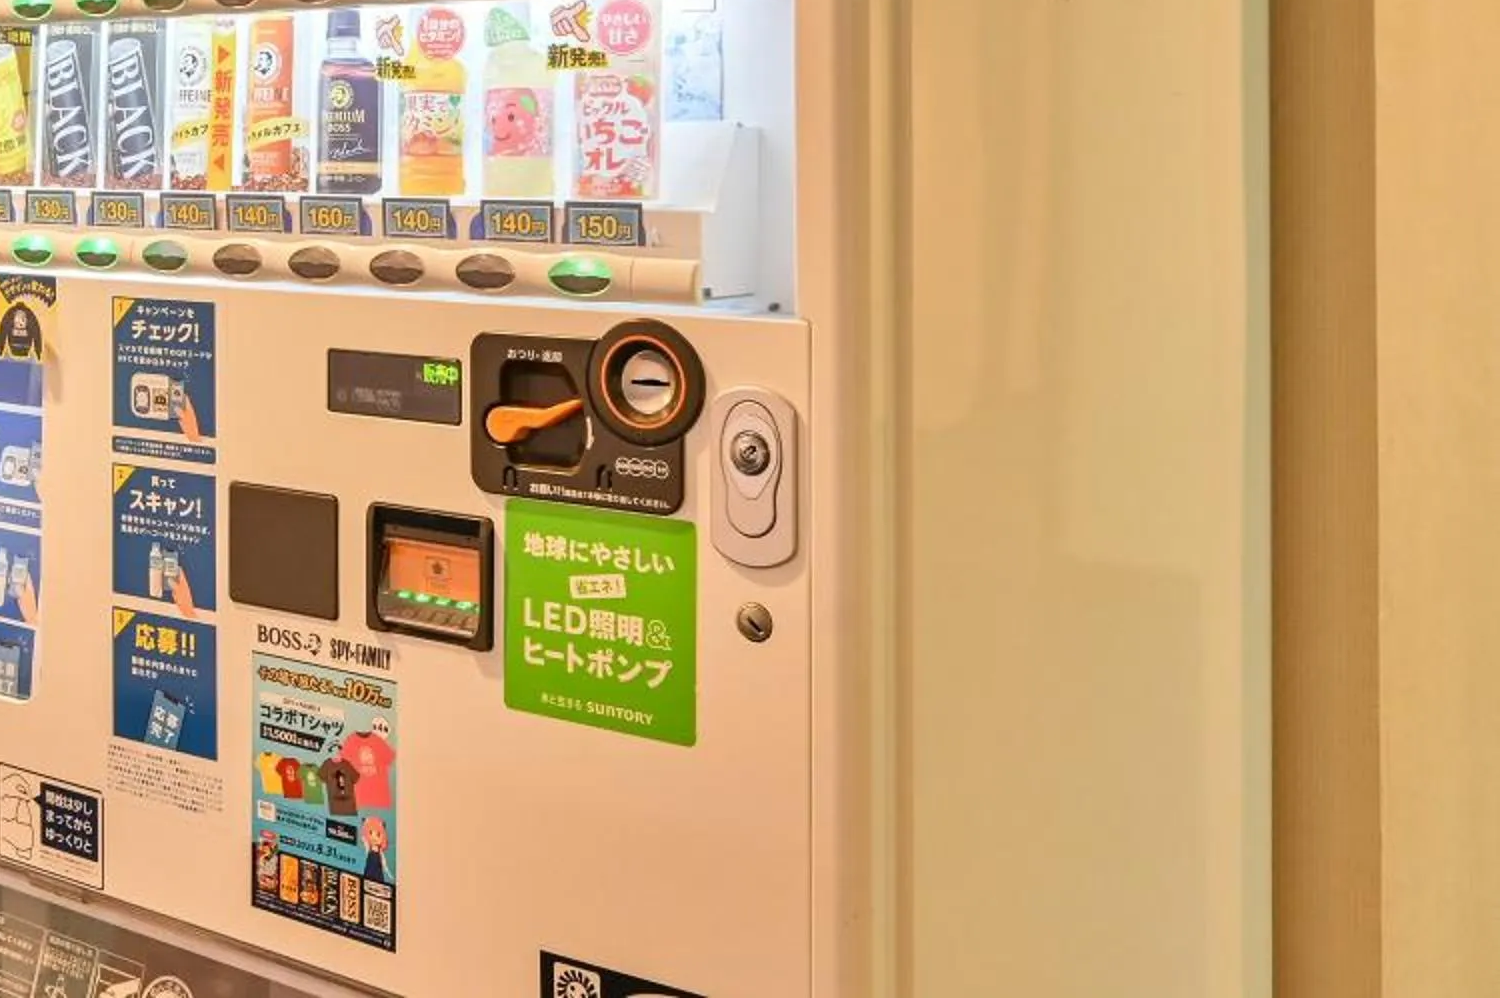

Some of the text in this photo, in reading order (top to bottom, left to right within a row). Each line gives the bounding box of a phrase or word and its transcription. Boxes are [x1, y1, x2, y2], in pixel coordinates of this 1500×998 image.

[583, 118, 645, 145] いちご
[584, 148, 627, 172] オレ
[236, 204, 280, 225] 140円
[307, 208, 354, 228] 160円
[391, 208, 442, 230] 140円
[491, 212, 548, 235] 140円
[577, 214, 633, 239] 150円
[131, 318, 200, 344] チェック!
[150, 474, 177, 490] 買って
[129, 489, 203, 519] スキャン!
[523, 530, 675, 574] 地球にやさしい
[575, 579, 621, 595] 省エネ!
[256, 623, 302, 651] BOSS
[523, 635, 674, 690] ヒートポンプ
[260, 704, 345, 737] コラボTシャツ
[586, 700, 654, 726] SUNTORY
[45, 827, 94, 854] ゆっくりと
